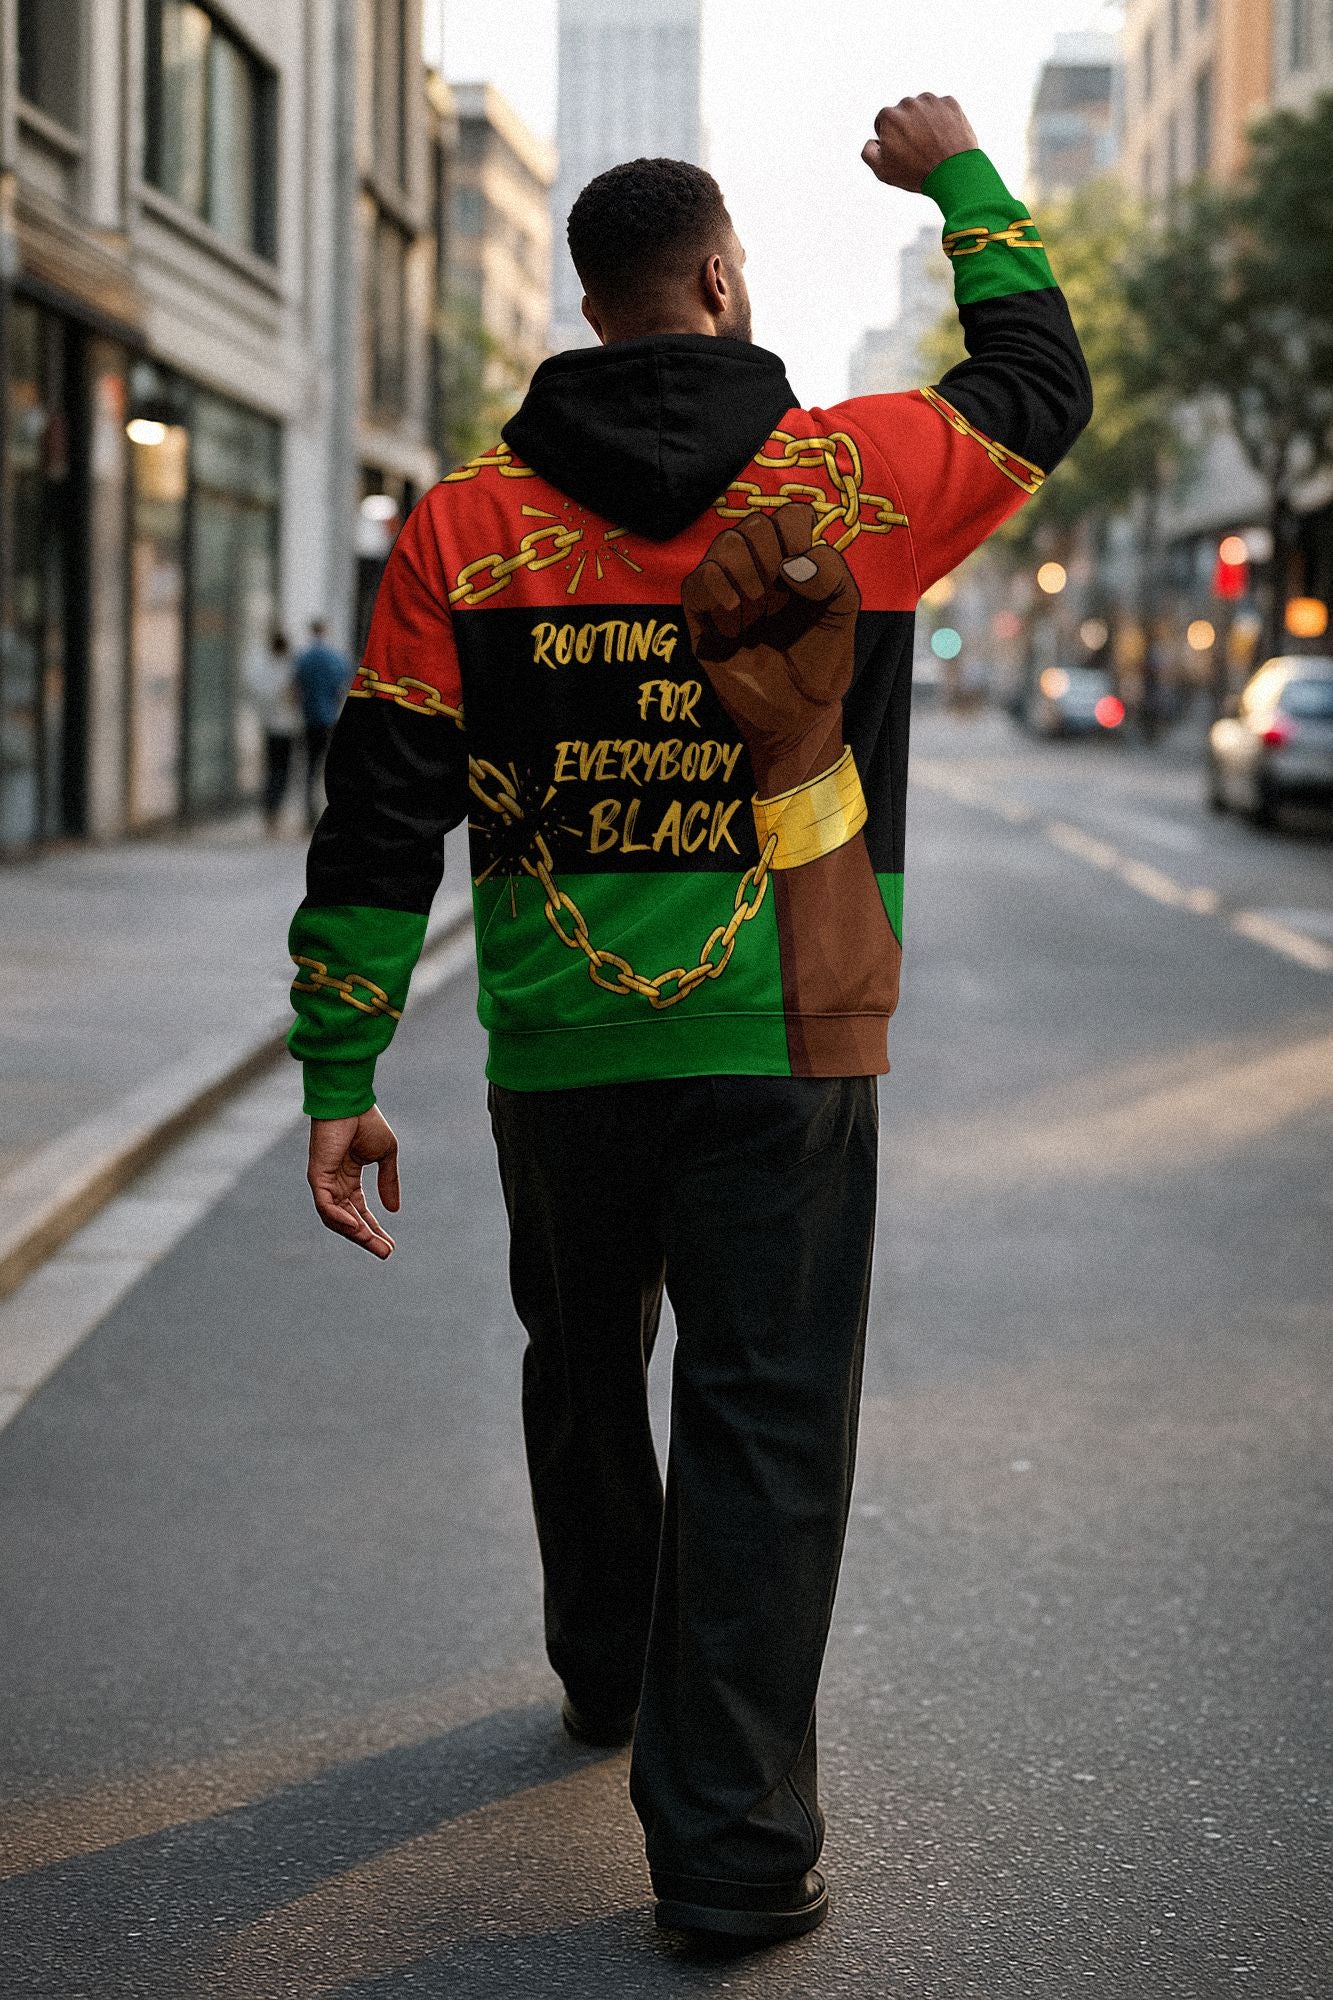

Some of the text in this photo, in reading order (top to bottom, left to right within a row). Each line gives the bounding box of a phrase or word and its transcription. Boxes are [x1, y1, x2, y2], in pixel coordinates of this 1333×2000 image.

[531, 619, 679, 669] ROOTING
[637, 679, 702, 728] FOR
[554, 738, 744, 786] EVERYBODY
[586, 798, 743, 857] BLACK
